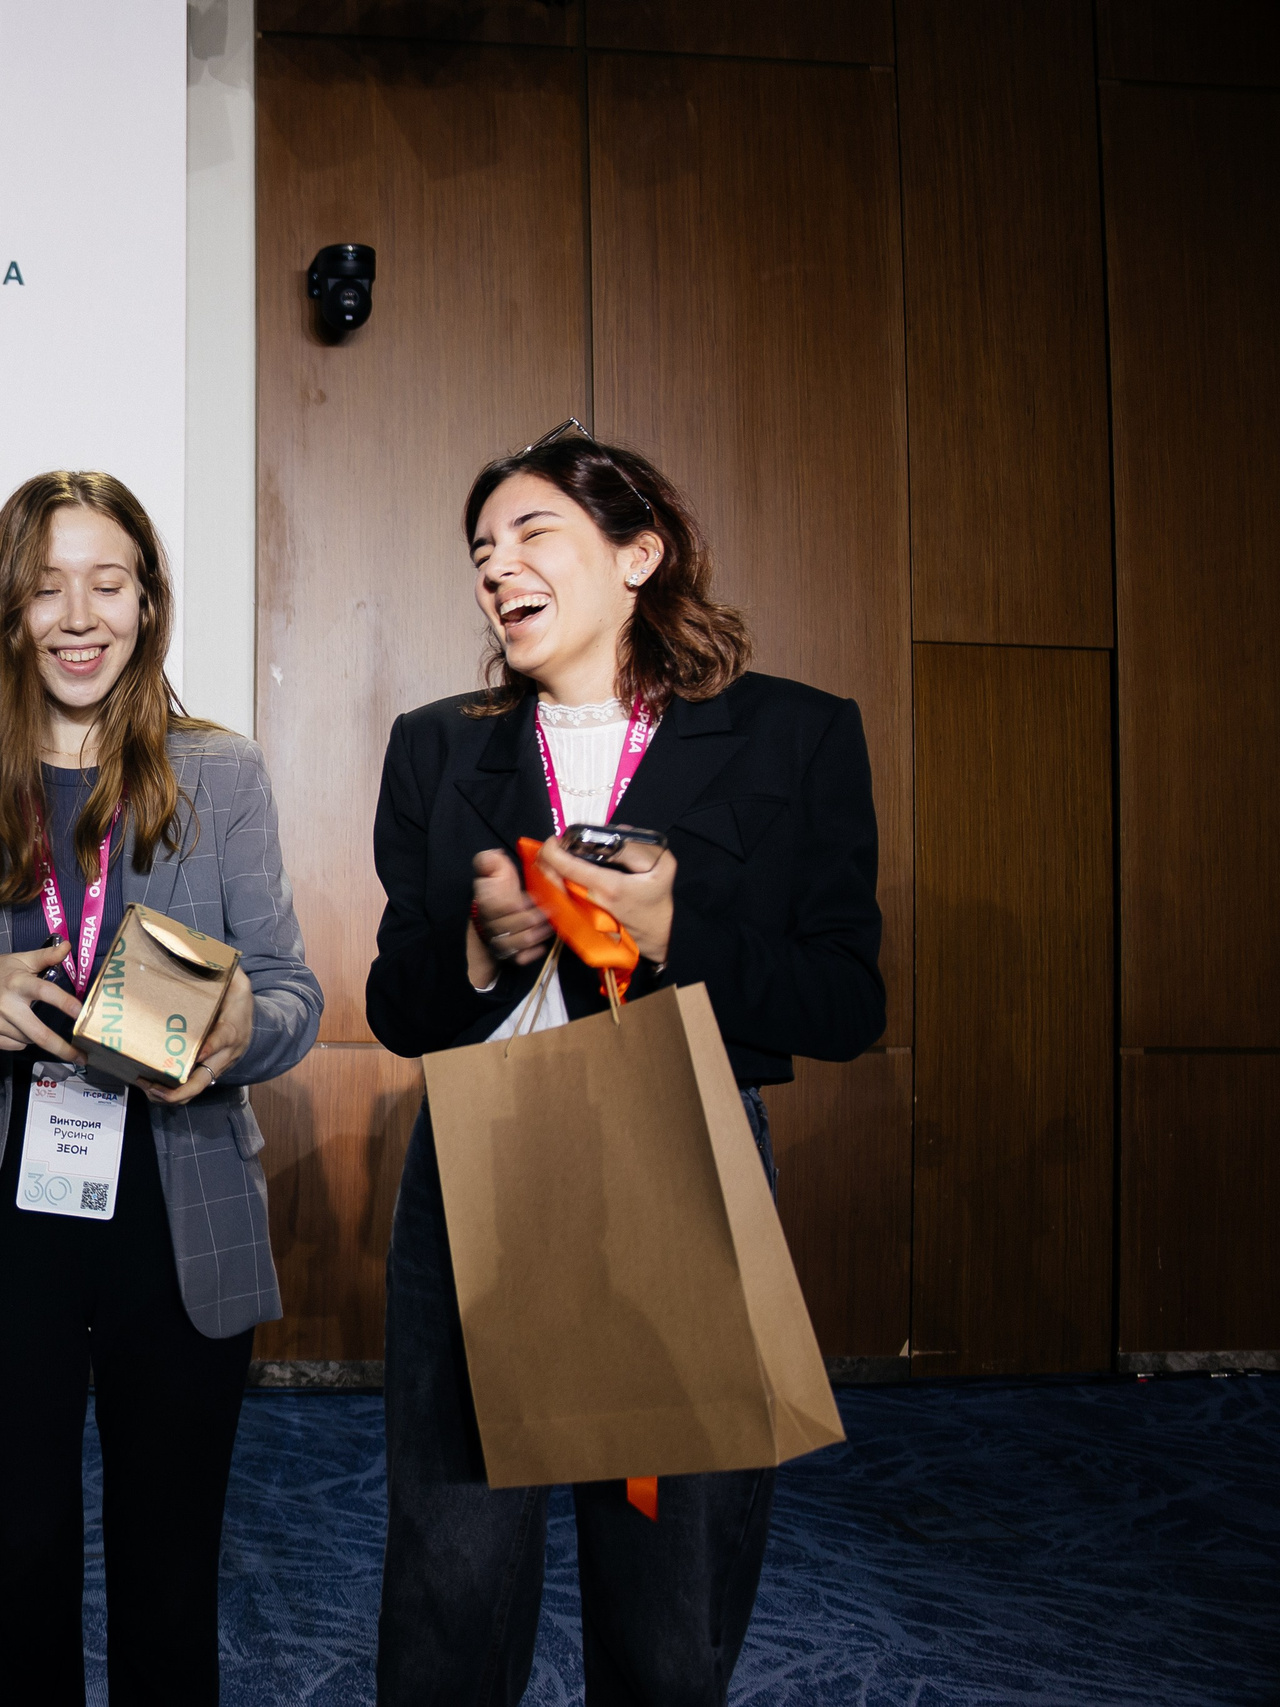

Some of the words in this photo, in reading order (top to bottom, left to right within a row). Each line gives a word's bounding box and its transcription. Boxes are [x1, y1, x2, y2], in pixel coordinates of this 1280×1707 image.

[79, 915, 97, 986] IT-СРЕДА
[83, 1091, 118, 1101] IT-СРЕДА
[50, 1115, 101, 1129] Виктория
[54, 1128, 94, 1141] Русина
[56, 1143, 88, 1155] ЗЕОН
